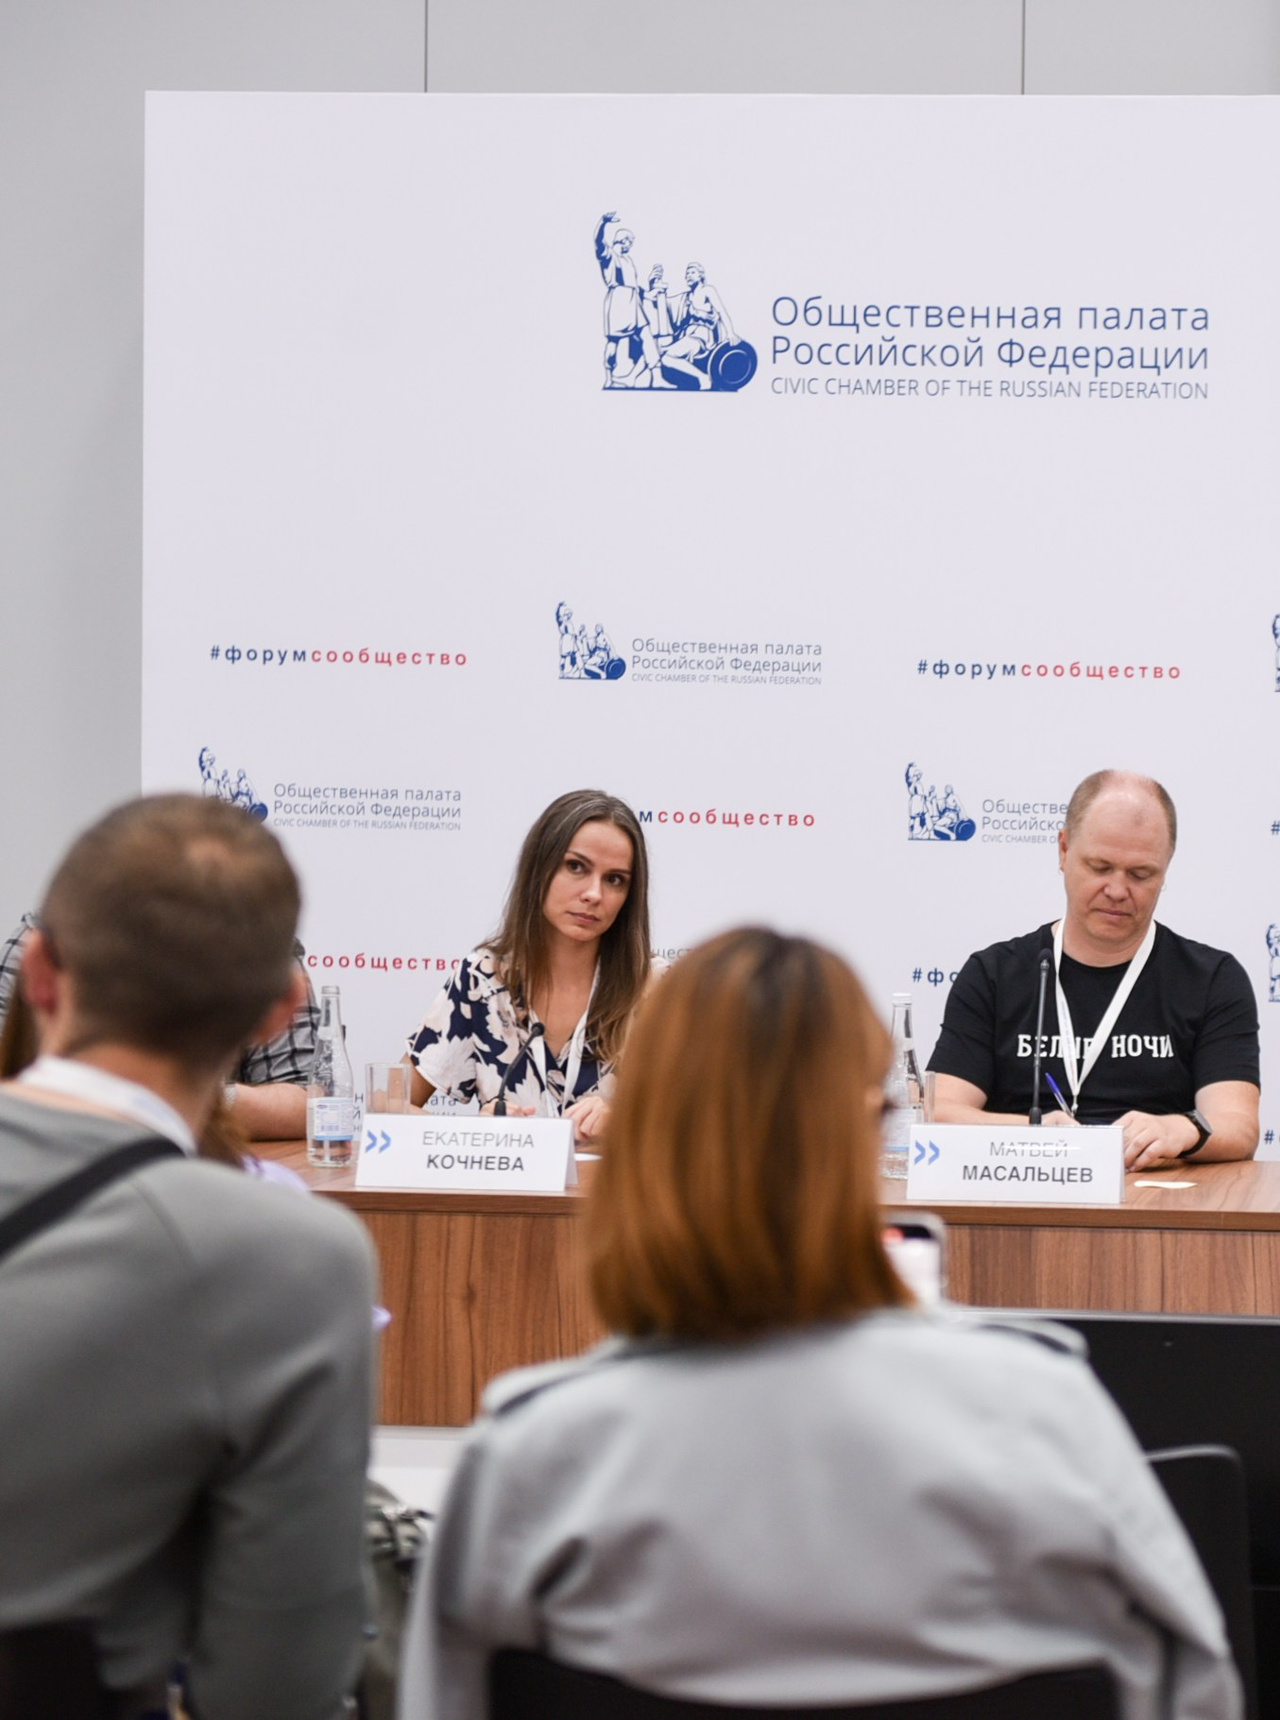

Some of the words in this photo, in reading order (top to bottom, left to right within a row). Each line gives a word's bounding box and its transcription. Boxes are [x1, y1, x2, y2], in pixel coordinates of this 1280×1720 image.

[772, 296, 1061, 334] Общественная
[1079, 307, 1208, 331] палата
[773, 336, 983, 367] Российской
[998, 339, 1207, 377] Федерации
[771, 377, 819, 394] CIVIC
[825, 378, 919, 396] CHAMBER
[925, 379, 951, 396] OF
[956, 380, 992, 397] THE
[1000, 380, 1081, 397] RUSSIAN
[1089, 382, 1207, 399] FEDERATION
[211, 645, 466, 666] #форумсообщество
[632, 638, 758, 655] Общественная
[765, 644, 821, 656] палата
[632, 655, 724, 670] Российской
[730, 657, 821, 675] Федерации
[917, 660, 1180, 680] #форумсообщество
[274, 783, 398, 800] Общественная
[405, 789, 461, 801] палата
[274, 800, 365, 816] Российской
[371, 803, 460, 820] Федерации
[982, 799, 1067, 816] Обществе
[639, 809, 815, 827] мсообщество
[982, 816, 1065, 831] Российско
[307, 953, 460, 971] сообщество
[1111, 1034, 1174, 1058] НОЧИ
[423, 1131, 534, 1148] ЕКАТЕРИНА
[990, 1140, 1067, 1157] МАТВЕЙ
[427, 1155, 524, 1171] КОЧНЕВА
[963, 1165, 1092, 1185] МАСАЛЬЦЕВ
